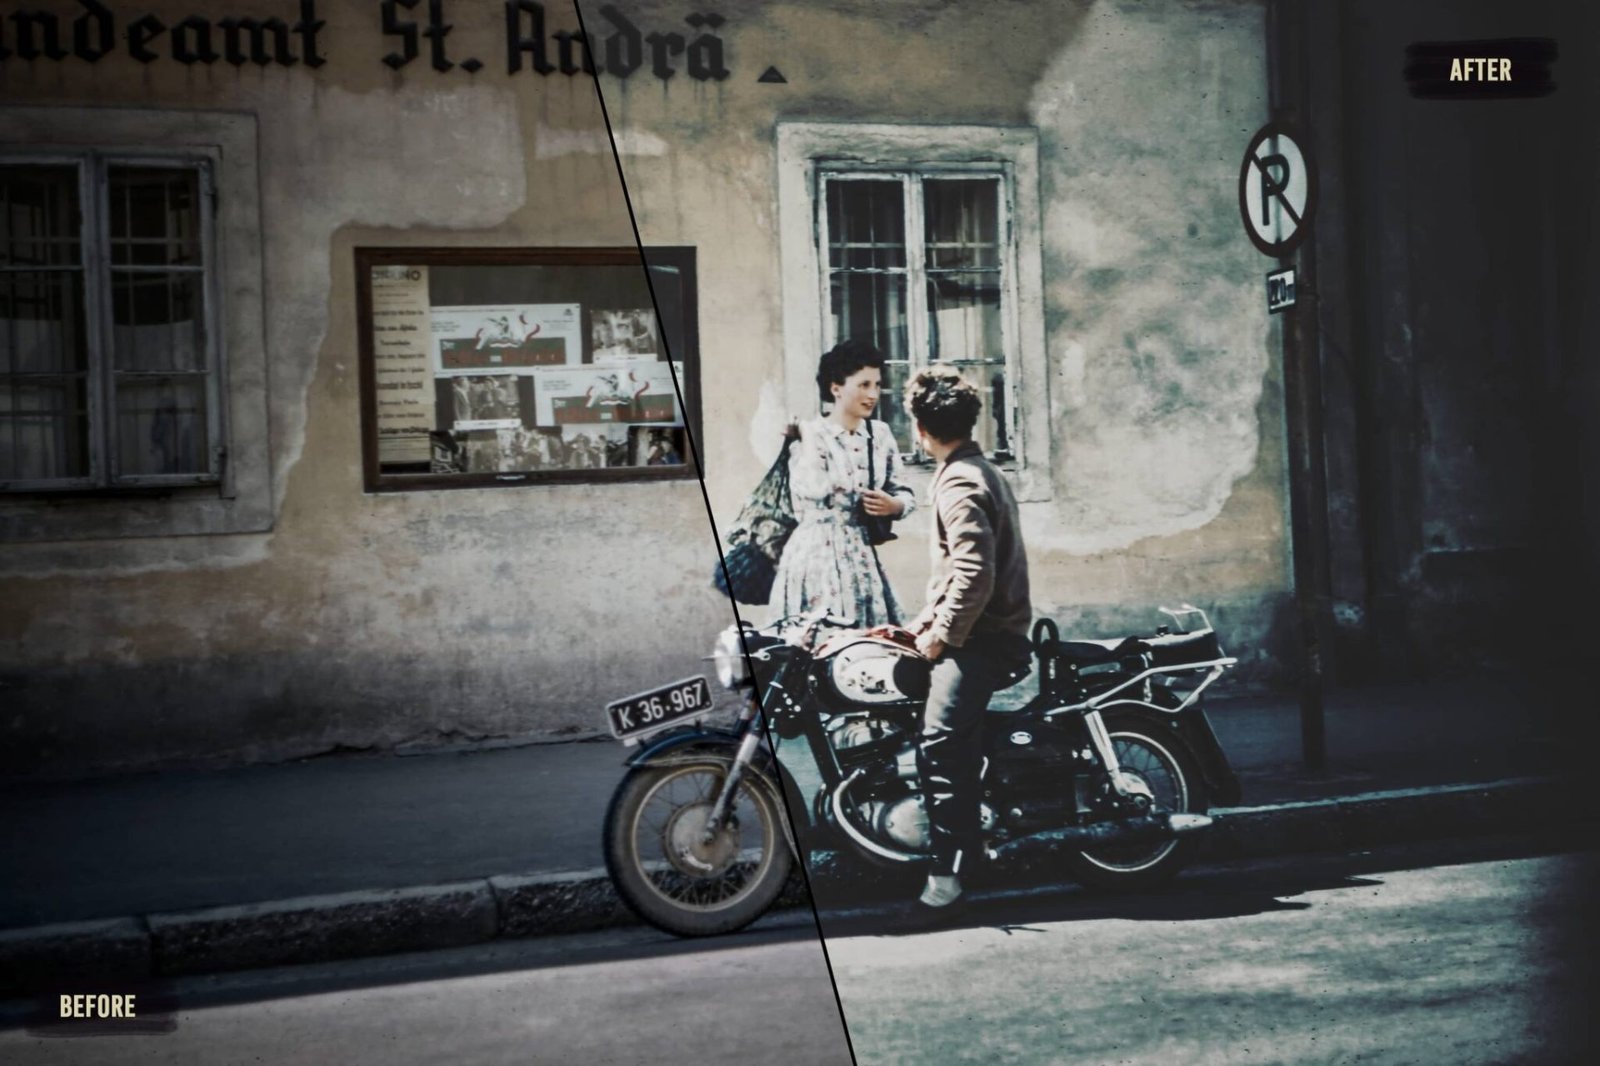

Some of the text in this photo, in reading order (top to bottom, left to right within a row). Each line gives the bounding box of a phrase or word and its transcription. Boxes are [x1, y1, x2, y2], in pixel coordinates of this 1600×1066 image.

[382, 0, 484, 72] St.
[507, 0, 731, 81] Andrä
[618, 705, 635, 730] K
